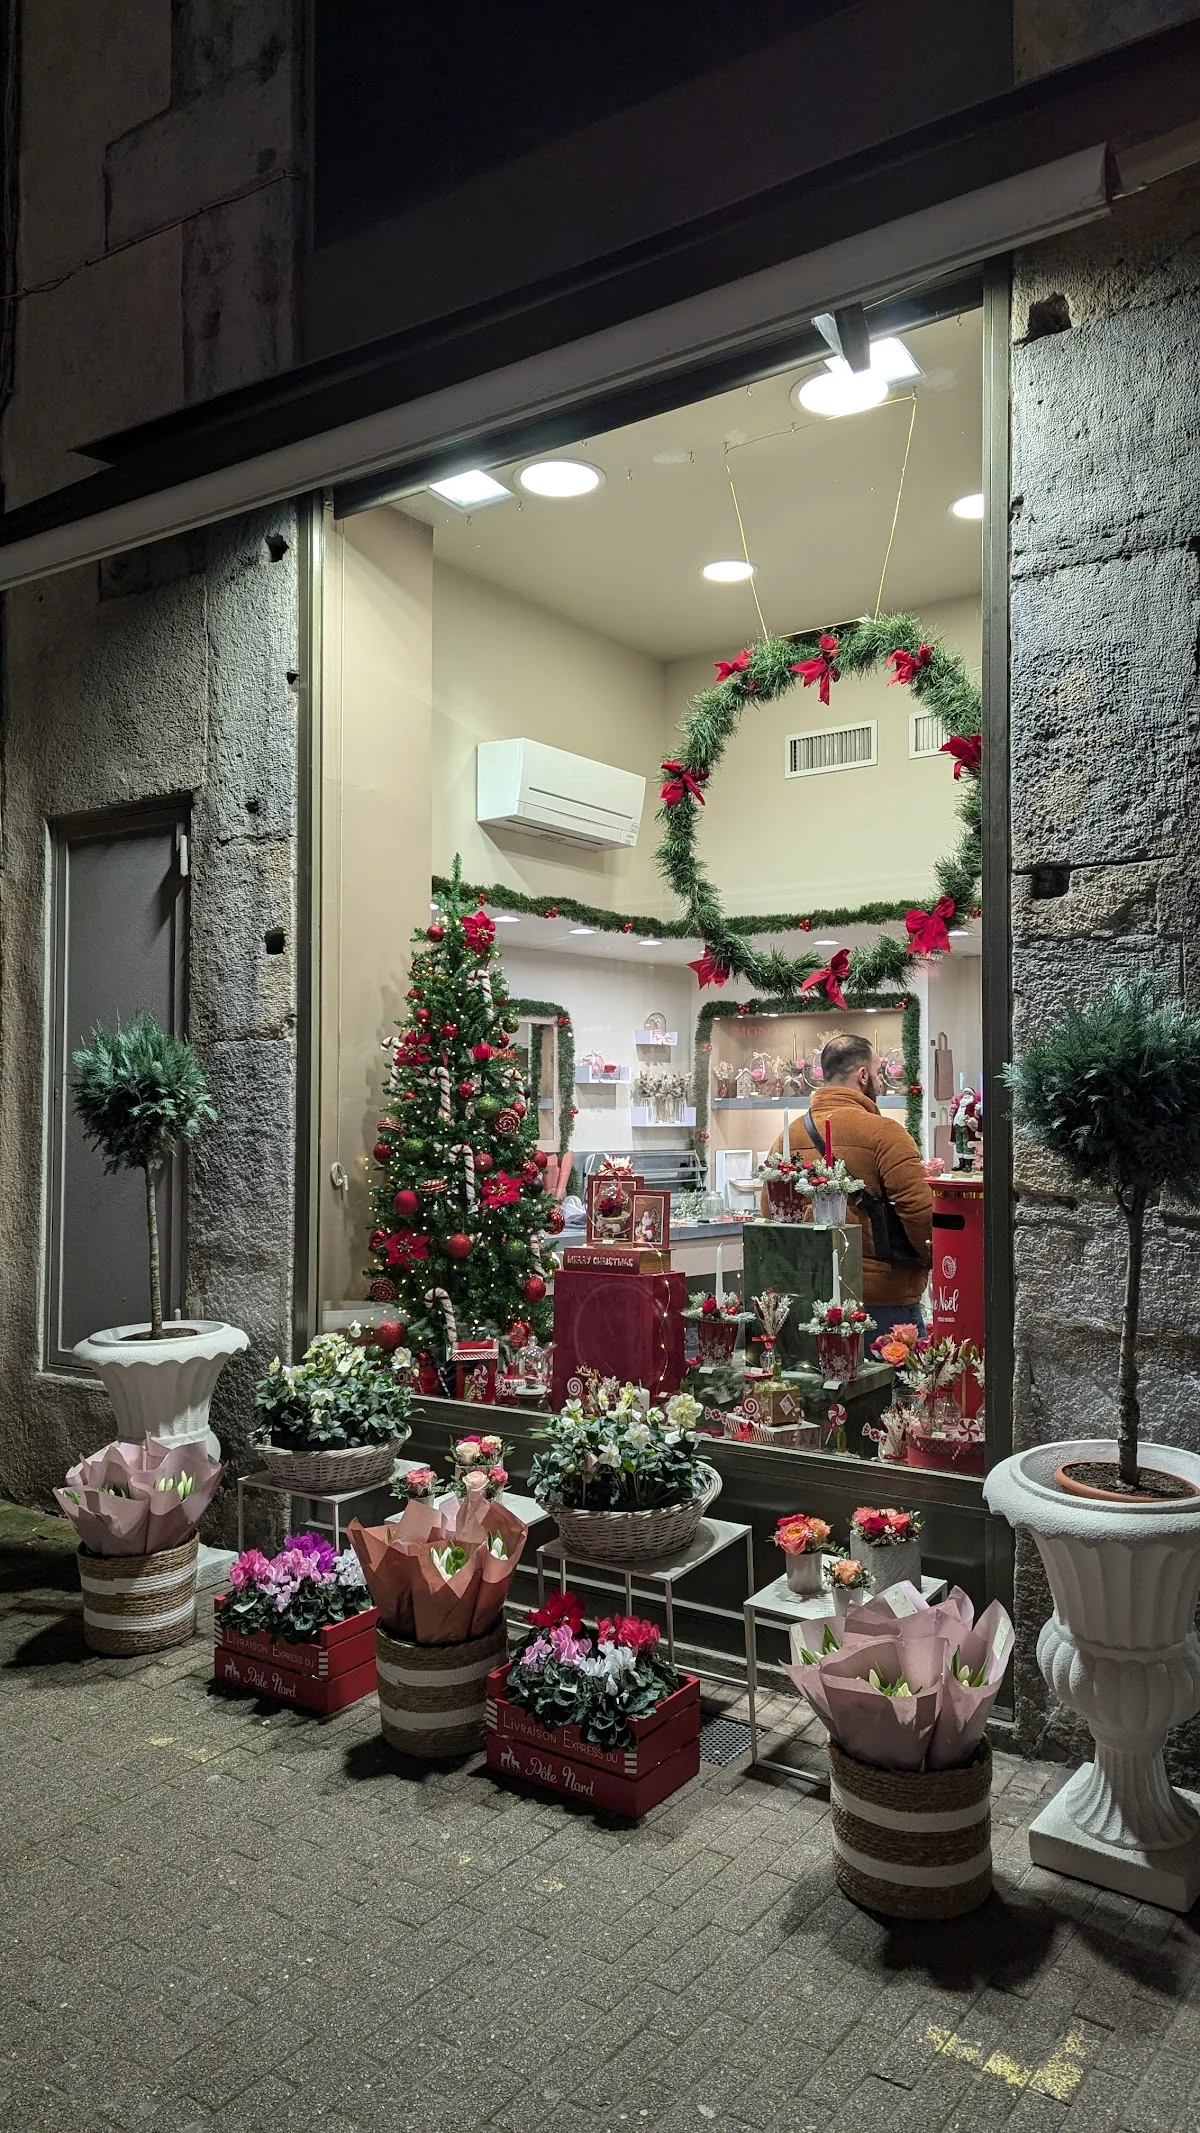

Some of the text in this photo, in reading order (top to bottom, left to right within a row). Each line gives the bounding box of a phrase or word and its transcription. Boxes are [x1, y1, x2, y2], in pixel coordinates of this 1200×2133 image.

[567, 1255, 634, 1268] MERRY CHRISTMAS
[938, 1286, 960, 1312] Noël
[243, 1666, 297, 1698] Pôle Nord
[525, 1757, 595, 1797] Pôle Nord
